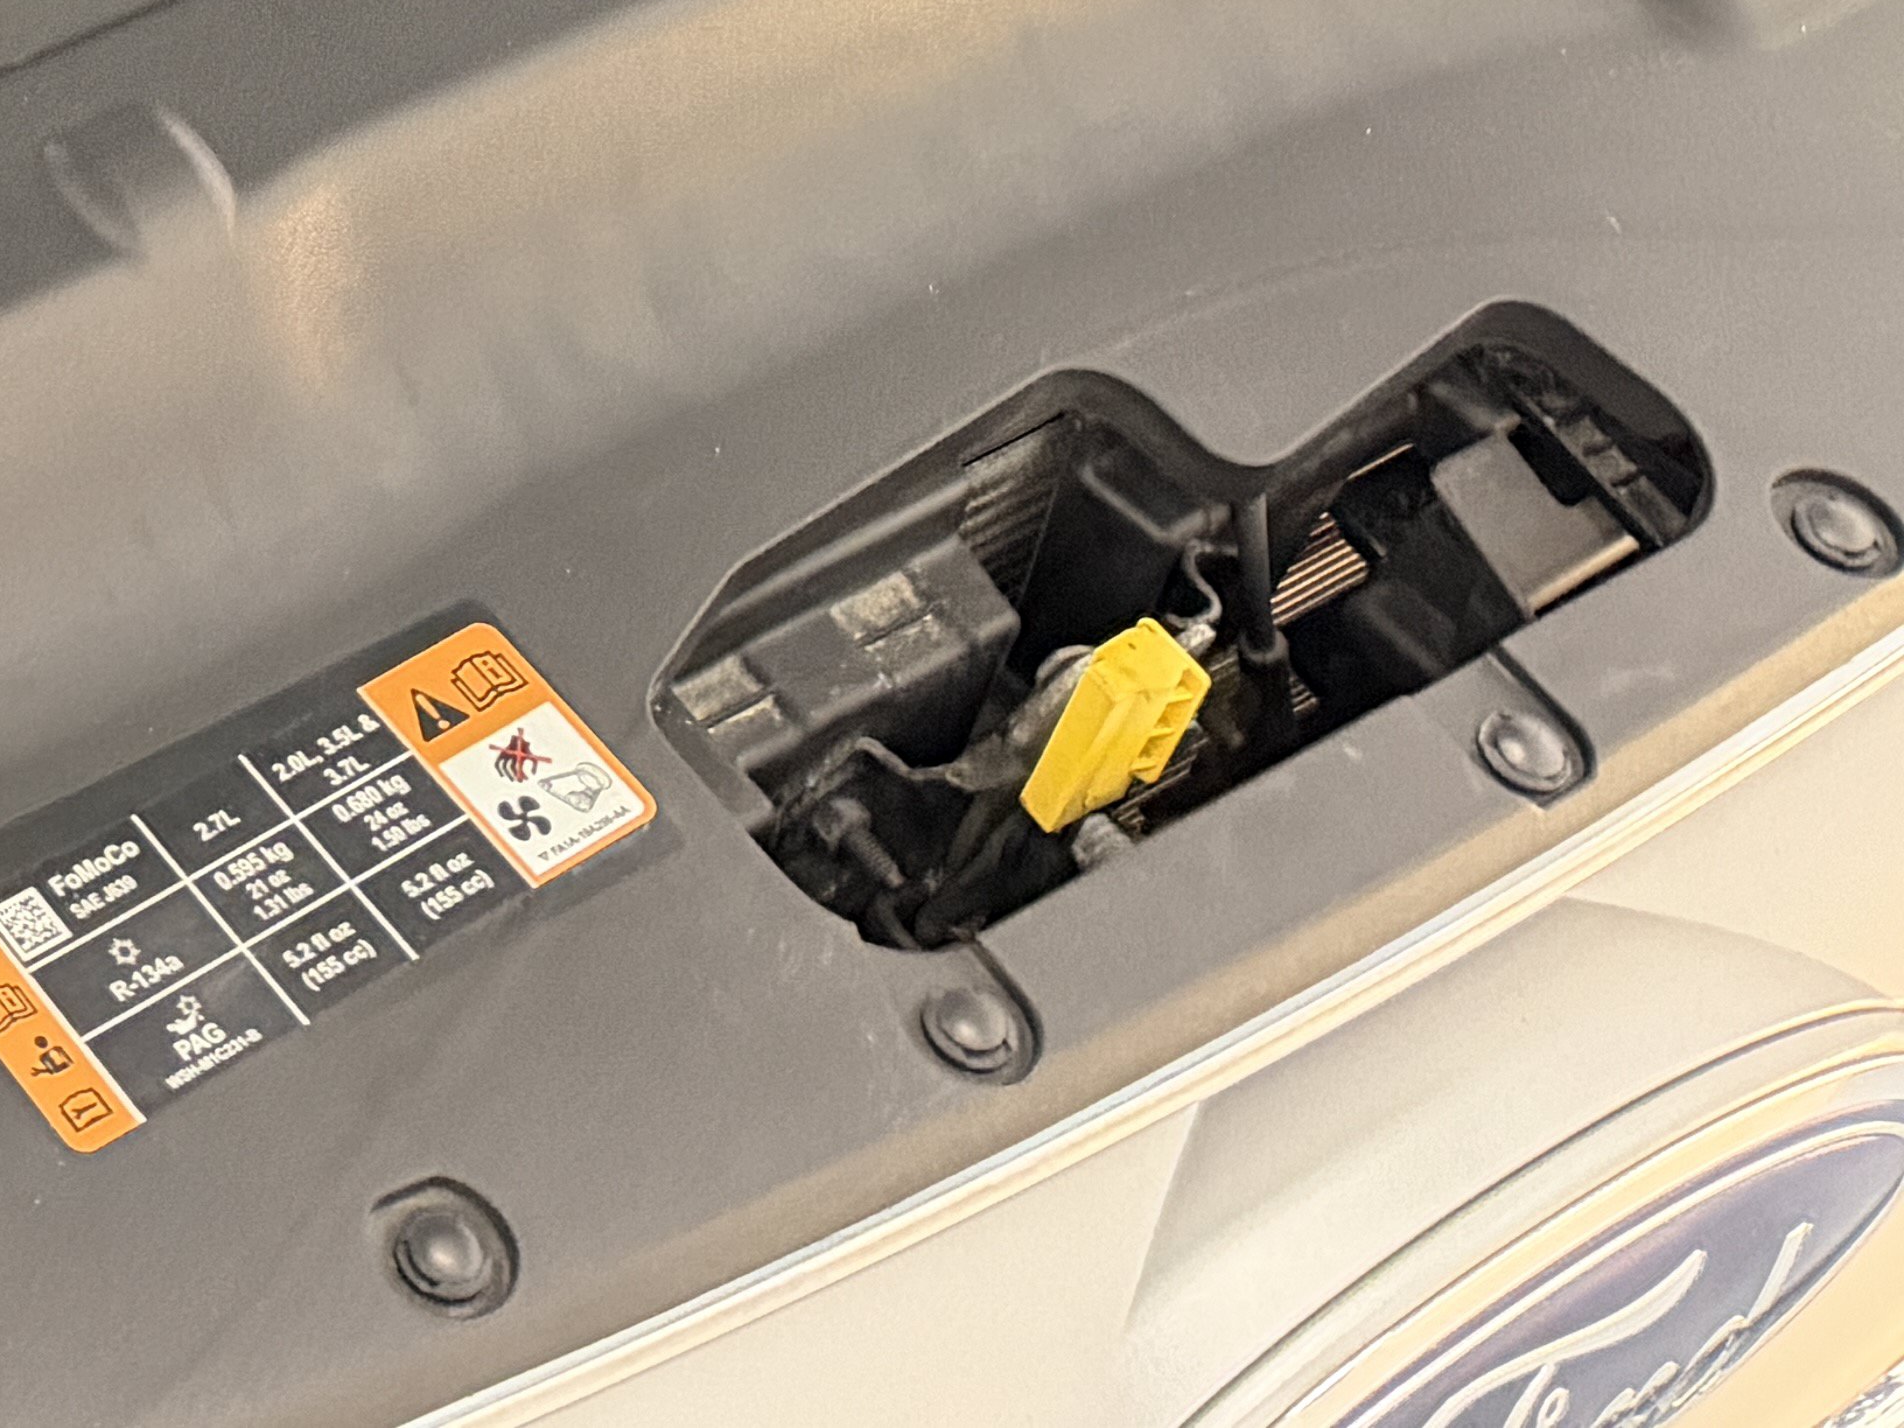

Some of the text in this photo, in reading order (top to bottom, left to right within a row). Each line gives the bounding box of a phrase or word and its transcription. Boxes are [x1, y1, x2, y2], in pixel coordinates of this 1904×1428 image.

[272, 713, 381, 782] 2.0L, 3.5L &
[323, 756, 372, 786] 3.7L
[331, 774, 412, 823] 0.680 kg
[363, 801, 410, 832] 24 oz
[193, 809, 241, 842] 2.7L
[371, 813, 432, 852] 1.50 lbs
[47, 840, 141, 897] FoMoCo
[213, 842, 294, 891] 0.595 kg
[245, 869, 292, 900] 21 oz
[400, 852, 475, 899] 5.2 fl oz
[69, 891, 106, 920] SAE
[253, 882, 315, 921] 1.31 lbs
[420, 868, 495, 921] (155 cc)
[282, 921, 356, 968] 5.2 fl oz
[301, 938, 377, 992] (155 cc)
[108, 955, 185, 1002] R-134a
[172, 1022, 227, 1062] PAG
